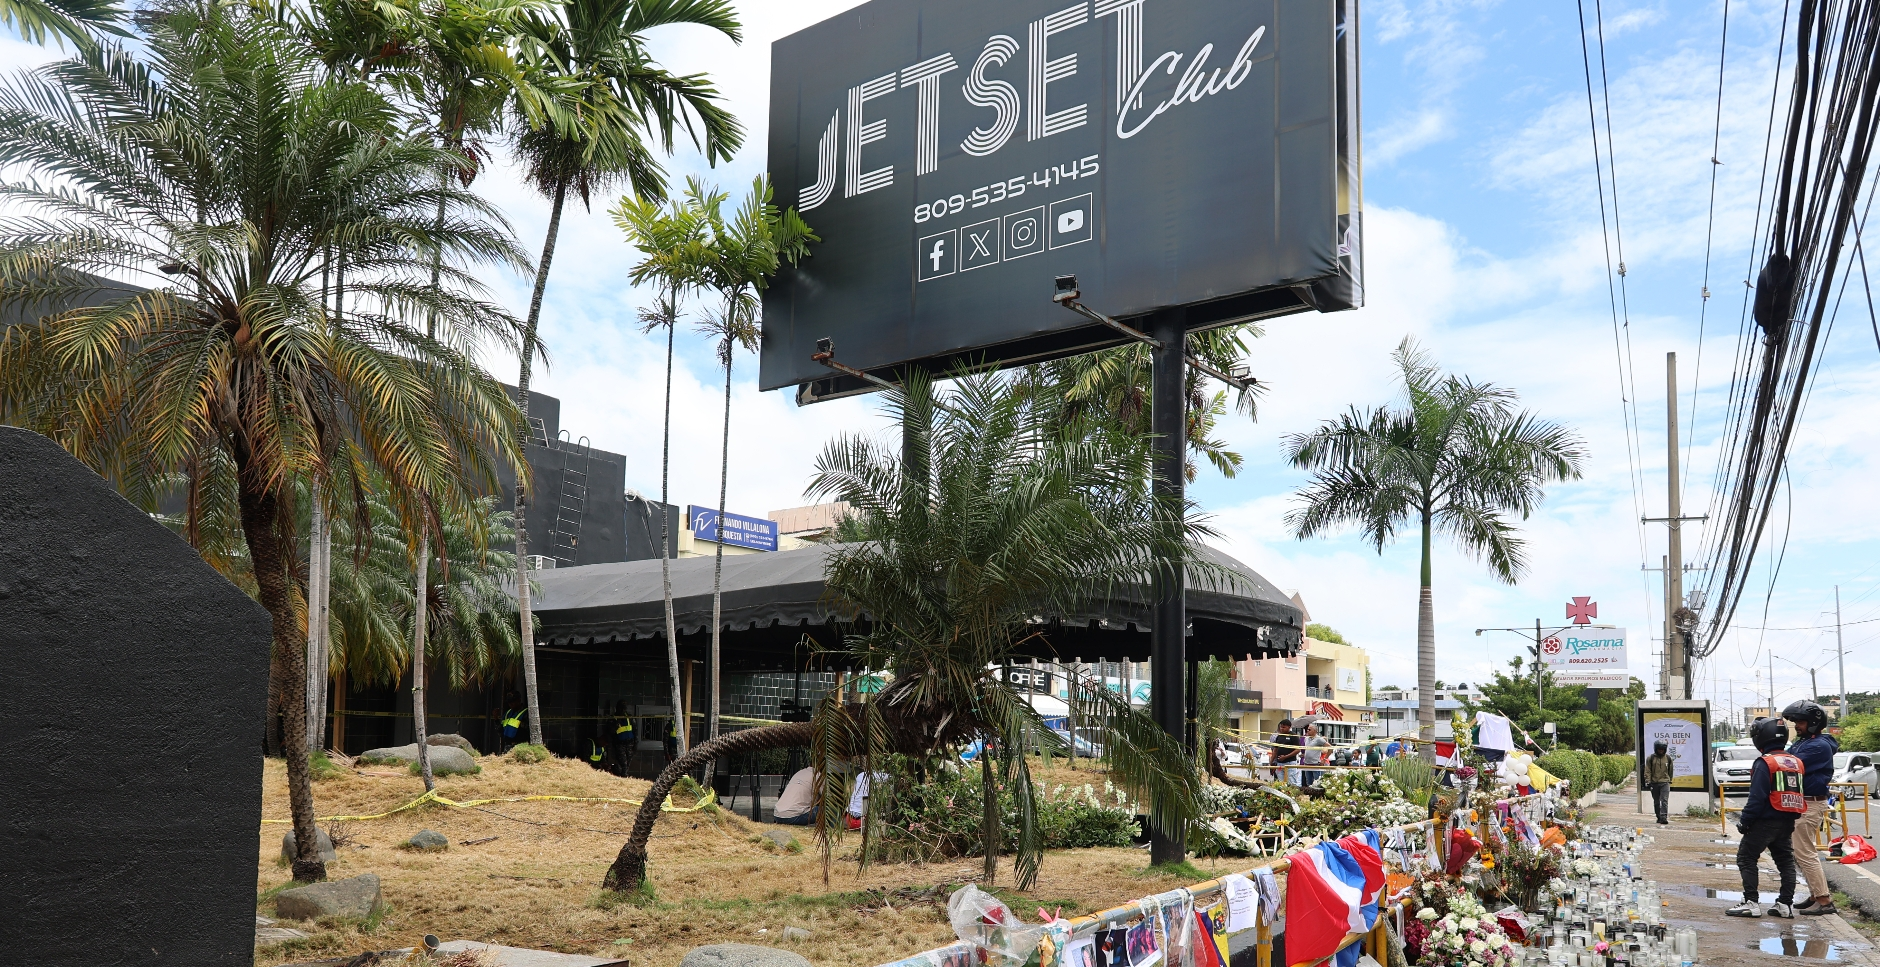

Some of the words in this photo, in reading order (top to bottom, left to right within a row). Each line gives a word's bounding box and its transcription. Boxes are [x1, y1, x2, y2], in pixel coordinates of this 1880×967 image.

[799, 0, 1146, 213] JETSET
[1117, 25, 1266, 139] Club
[913, 154, 1101, 224] 809-535-4145
[714, 515, 742, 530] FNANDO
[742, 520, 770, 535] VILLALONA
[721, 529, 743, 541] RQUESTA
[1565, 637, 1624, 655] Rosanna
